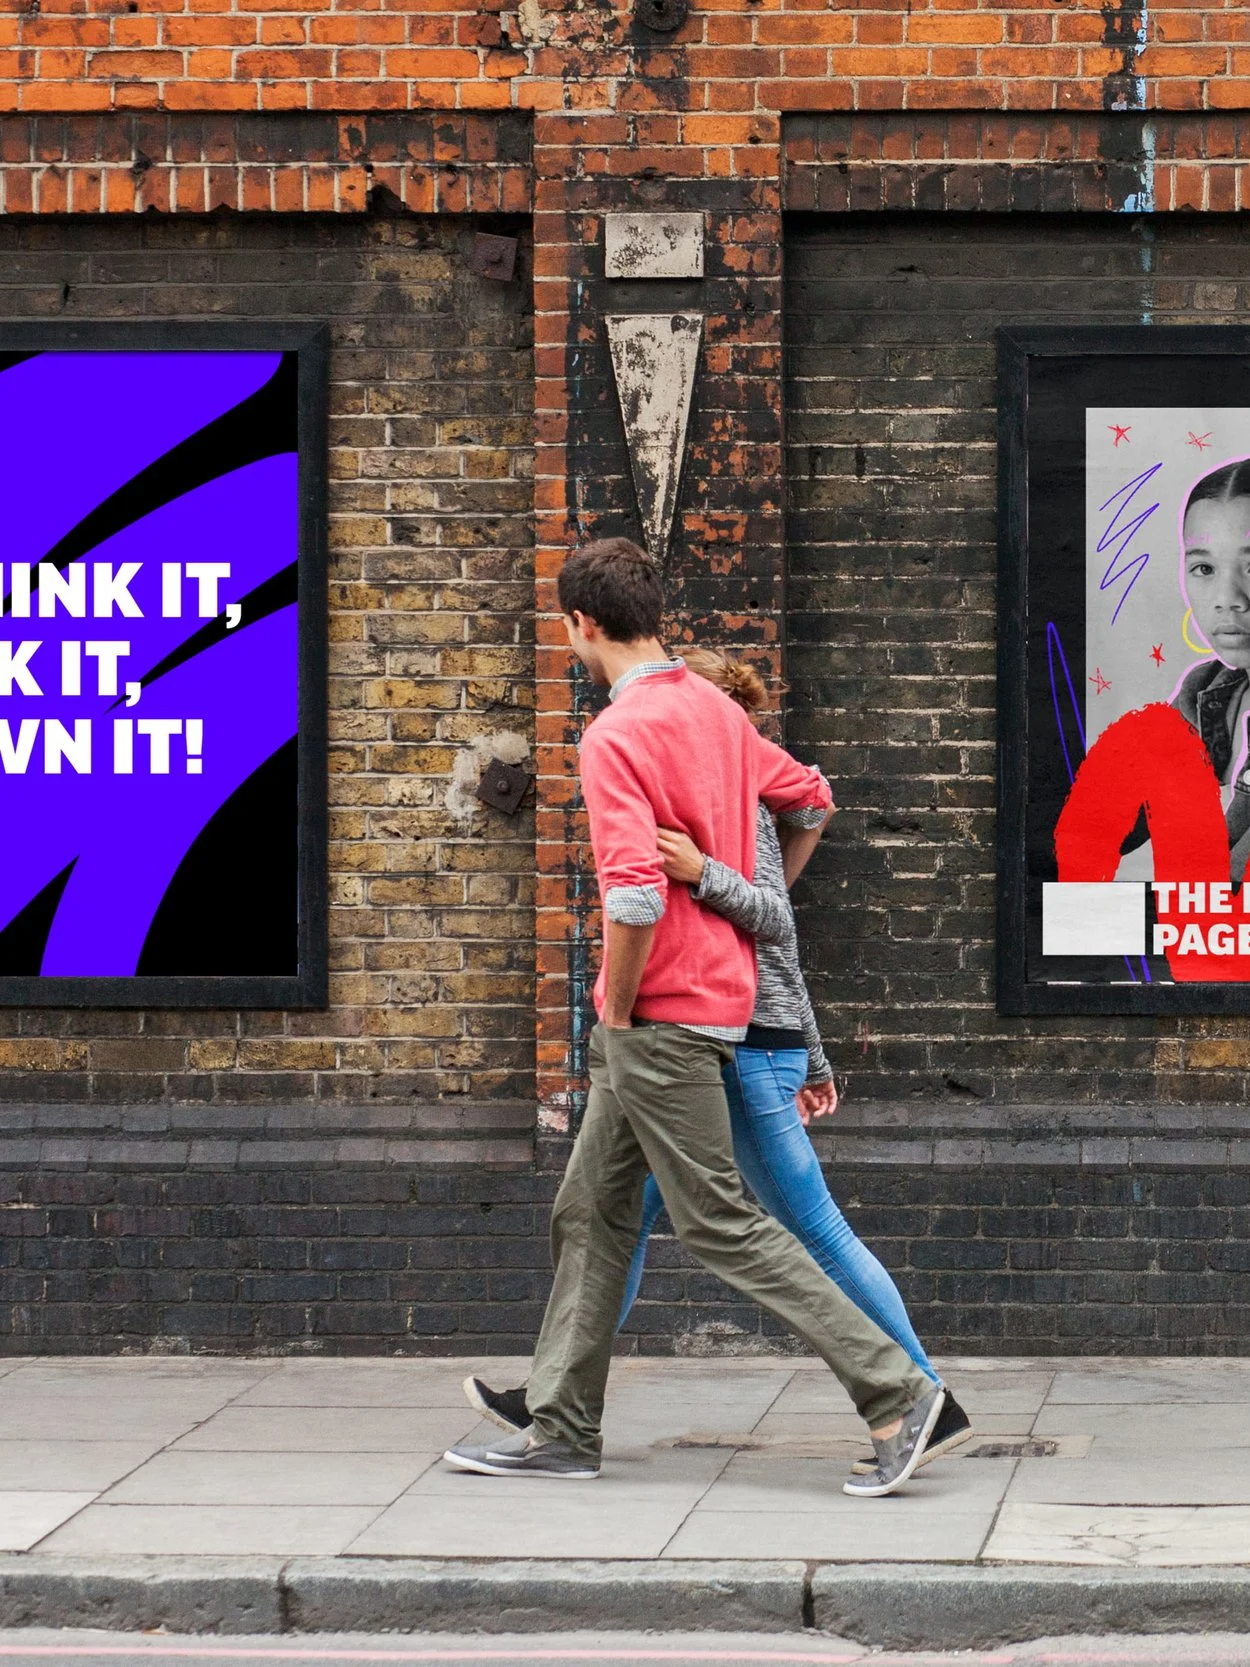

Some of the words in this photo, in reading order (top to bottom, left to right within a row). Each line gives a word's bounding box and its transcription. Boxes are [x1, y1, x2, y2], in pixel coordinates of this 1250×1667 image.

[0, 563, 144, 617] INK
[162, 563, 241, 628] IT,
[62, 641, 141, 707] IT,
[114, 719, 203, 774] IT!
[1151, 882, 1233, 914] THE
